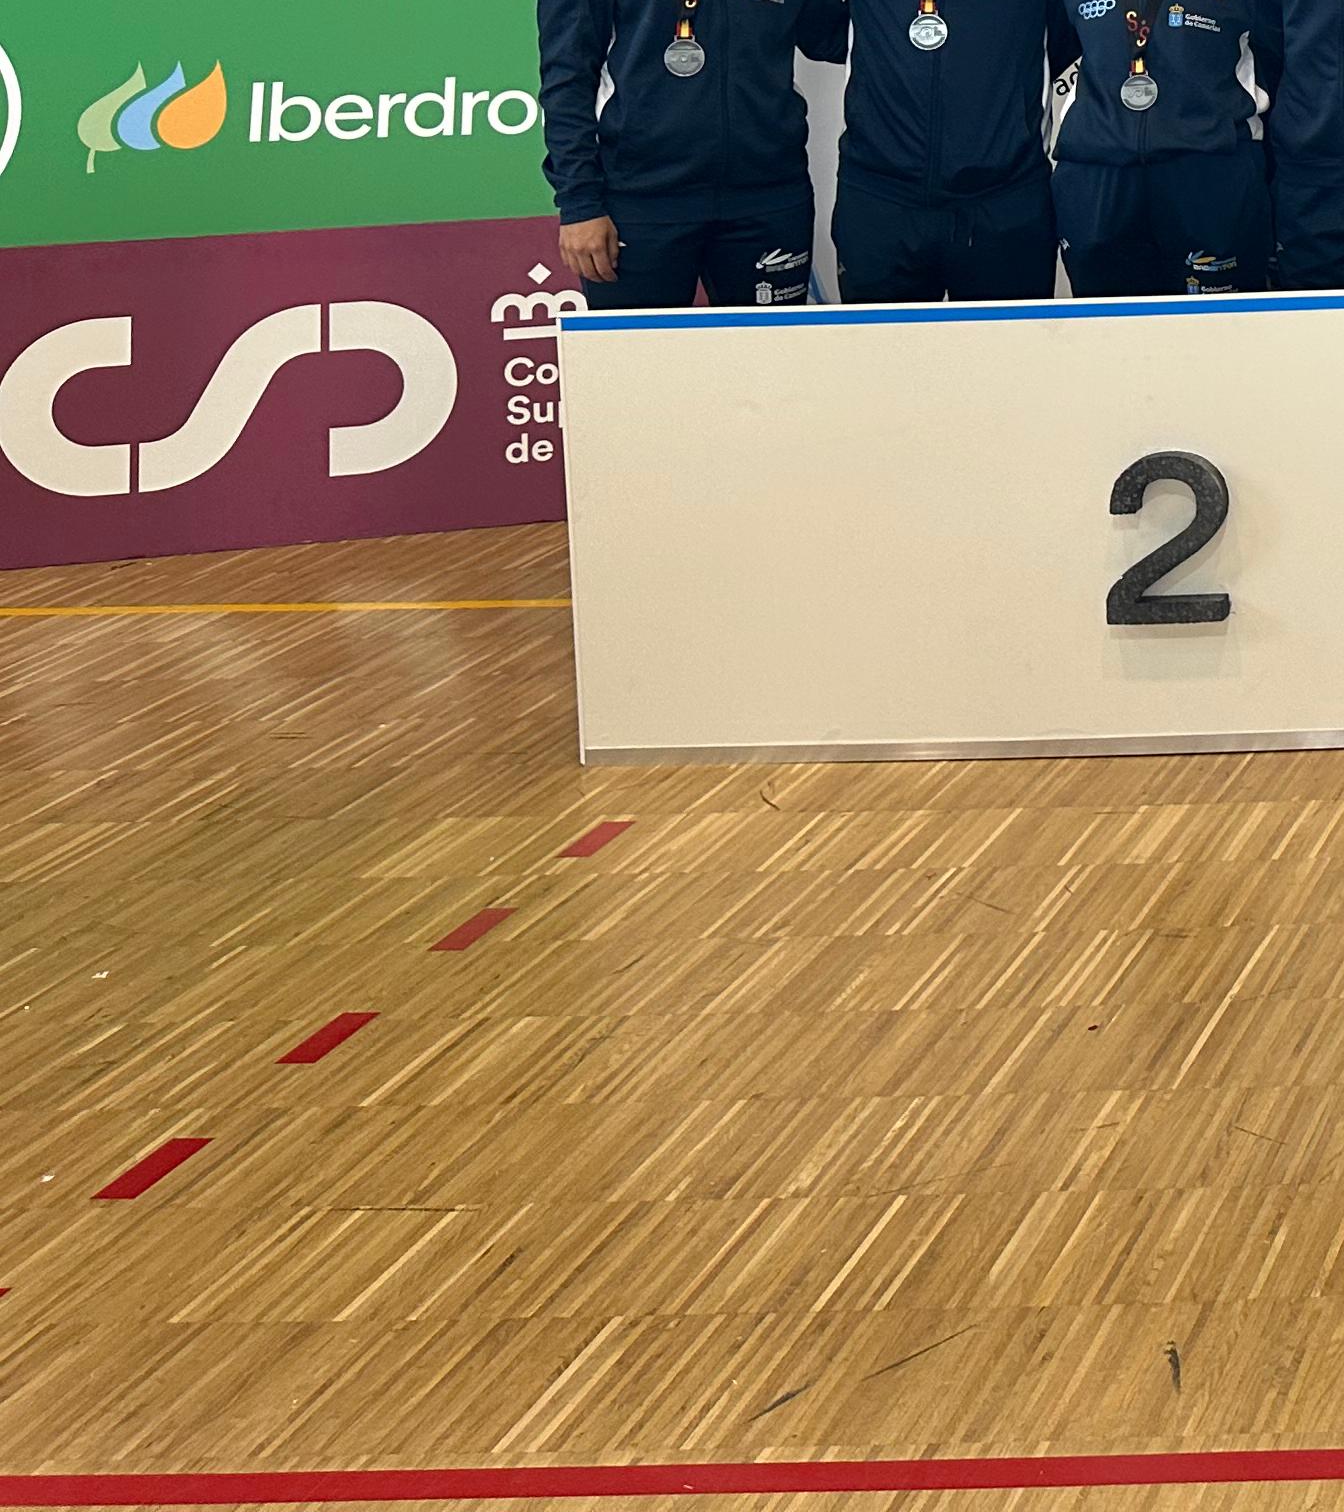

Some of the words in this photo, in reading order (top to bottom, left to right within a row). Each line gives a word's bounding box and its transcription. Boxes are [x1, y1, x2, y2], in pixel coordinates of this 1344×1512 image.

[248, 76, 543, 143] Iberdro
[506, 434, 554, 463] de
[1107, 450, 1231, 625] 2
